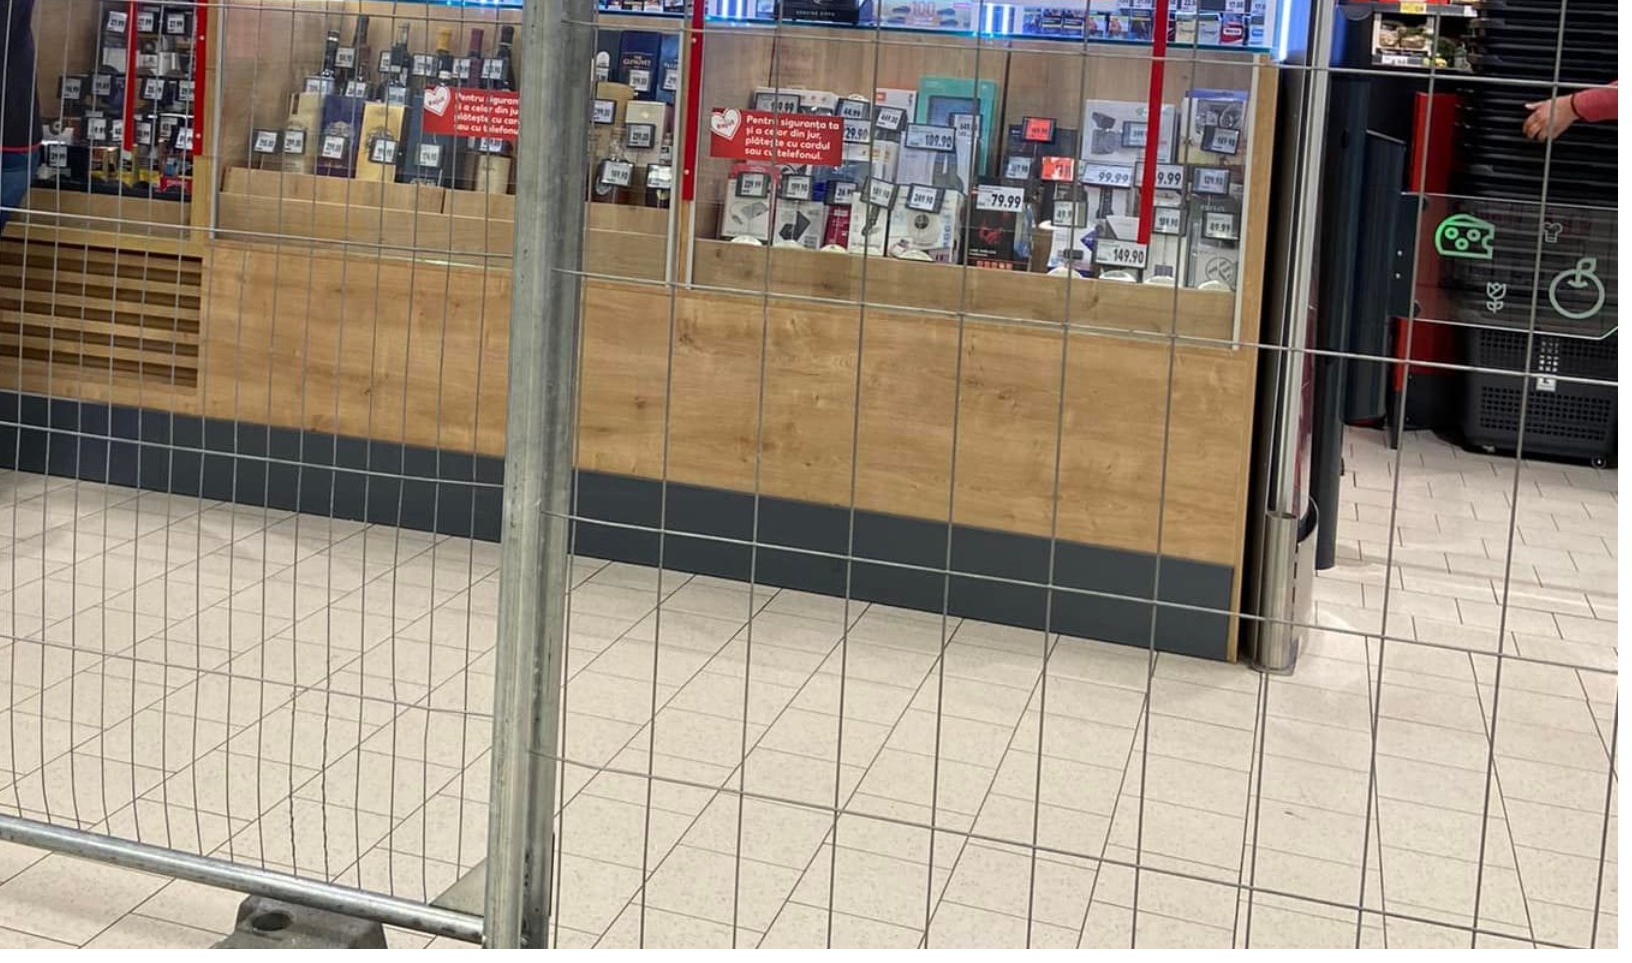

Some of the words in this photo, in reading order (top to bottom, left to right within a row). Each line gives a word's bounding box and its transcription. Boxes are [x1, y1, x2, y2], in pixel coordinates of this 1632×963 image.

[494, 105, 509, 114] din
[828, 121, 840, 130] ta
[790, 128, 806, 137] din
[799, 139, 831, 150] cardul
[745, 148, 761, 156] sau
[1098, 171, 1129, 184] 99.99
[991, 193, 1022, 209] 79.99
[1112, 248, 1145, 265] 149.90
